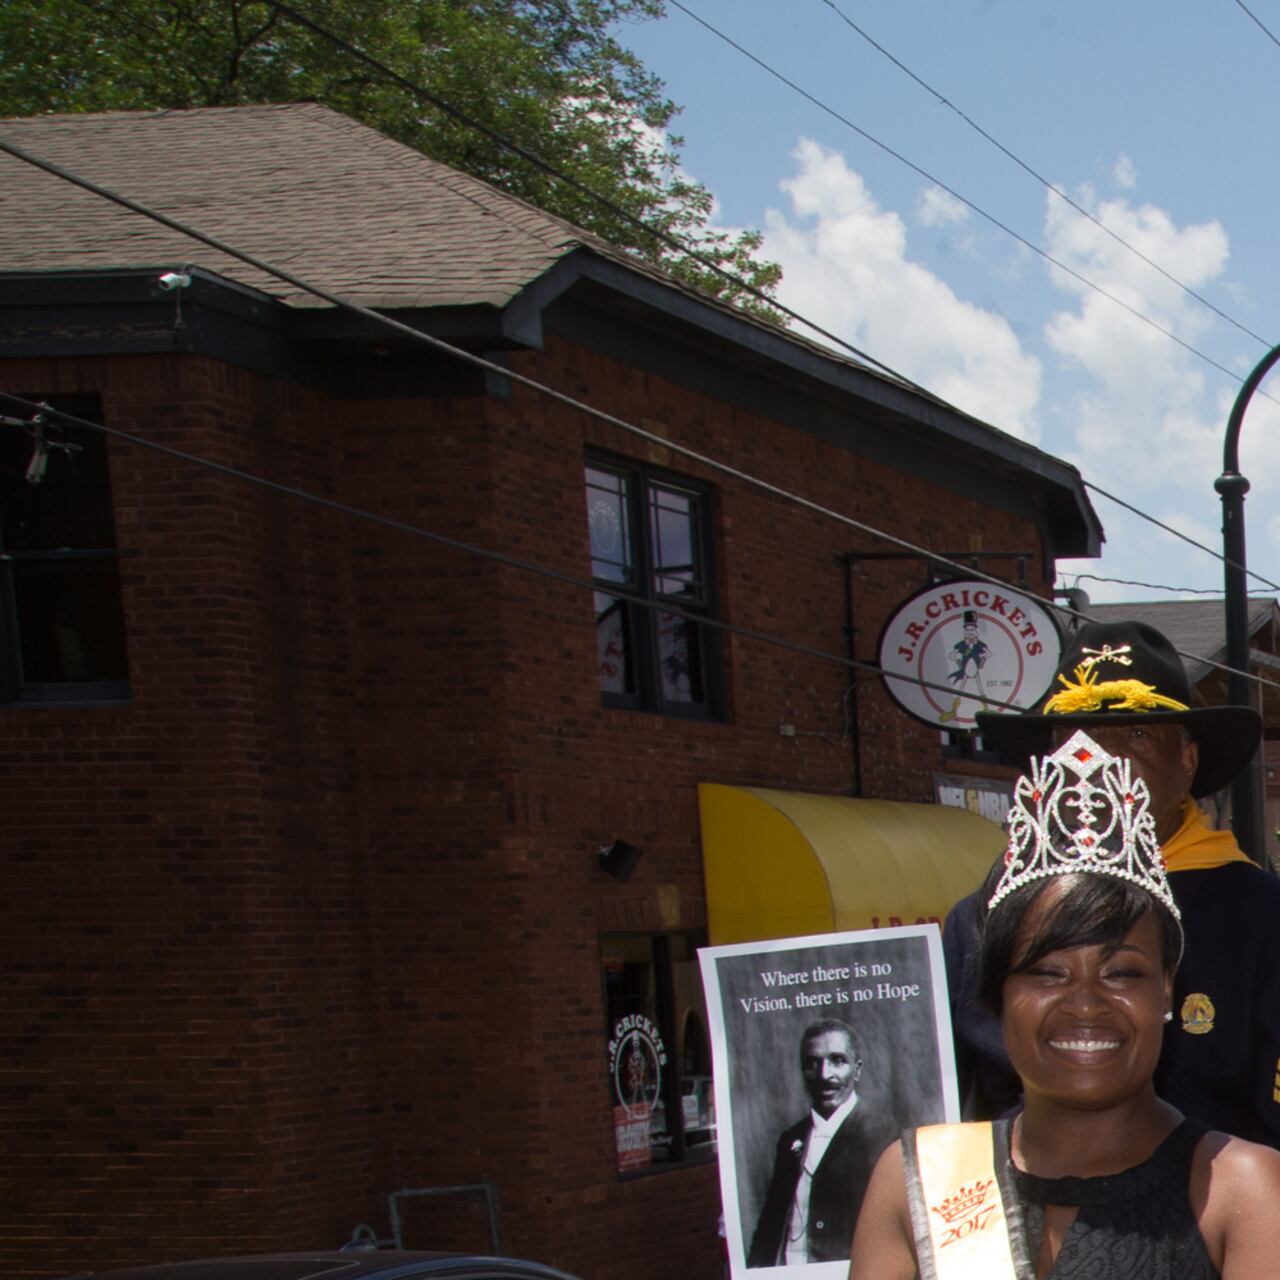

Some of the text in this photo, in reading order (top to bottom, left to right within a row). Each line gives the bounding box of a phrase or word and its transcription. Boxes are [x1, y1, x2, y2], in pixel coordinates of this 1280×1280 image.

[761, 962, 892, 988] Where there is no
[740, 981, 921, 1016] Vision, there is no Hope
[939, 1204, 997, 1249] 2017
